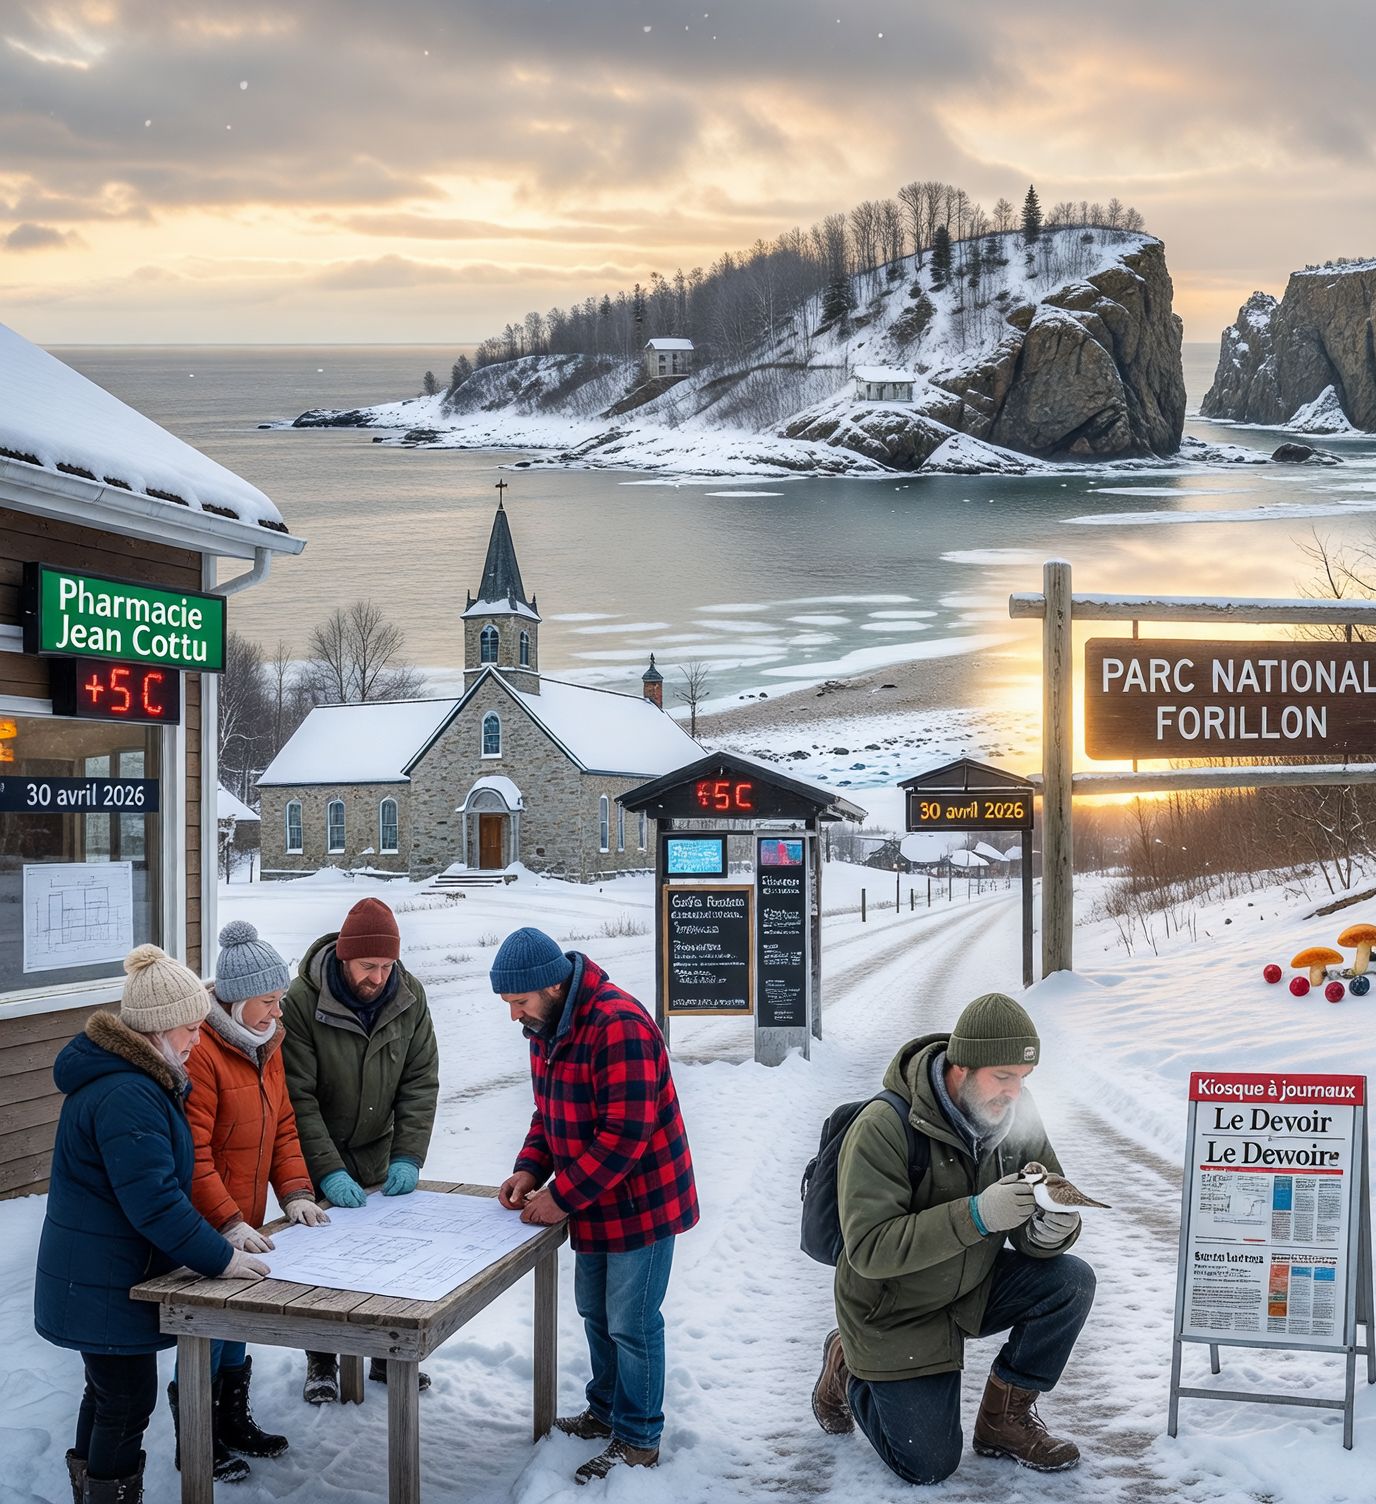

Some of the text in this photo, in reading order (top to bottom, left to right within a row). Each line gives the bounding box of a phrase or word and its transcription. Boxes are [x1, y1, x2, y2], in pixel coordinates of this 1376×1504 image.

[59, 577, 203, 630] Pharmacie
[56, 614, 207, 662] Jean Cottu
[1102, 658, 1195, 694] PARC
[1156, 705, 1328, 741] FORILLON
[26, 783, 51, 806] 30
[57, 783, 97, 806] avril
[103, 785, 145, 806] 2026
[920, 801, 1024, 820] 30 avril 2026
[1198, 1079, 1355, 1102] Kiosque à journaux
[1213, 1107, 1332, 1133] Le Devoir
[1205, 1141, 1236, 1163] Le
